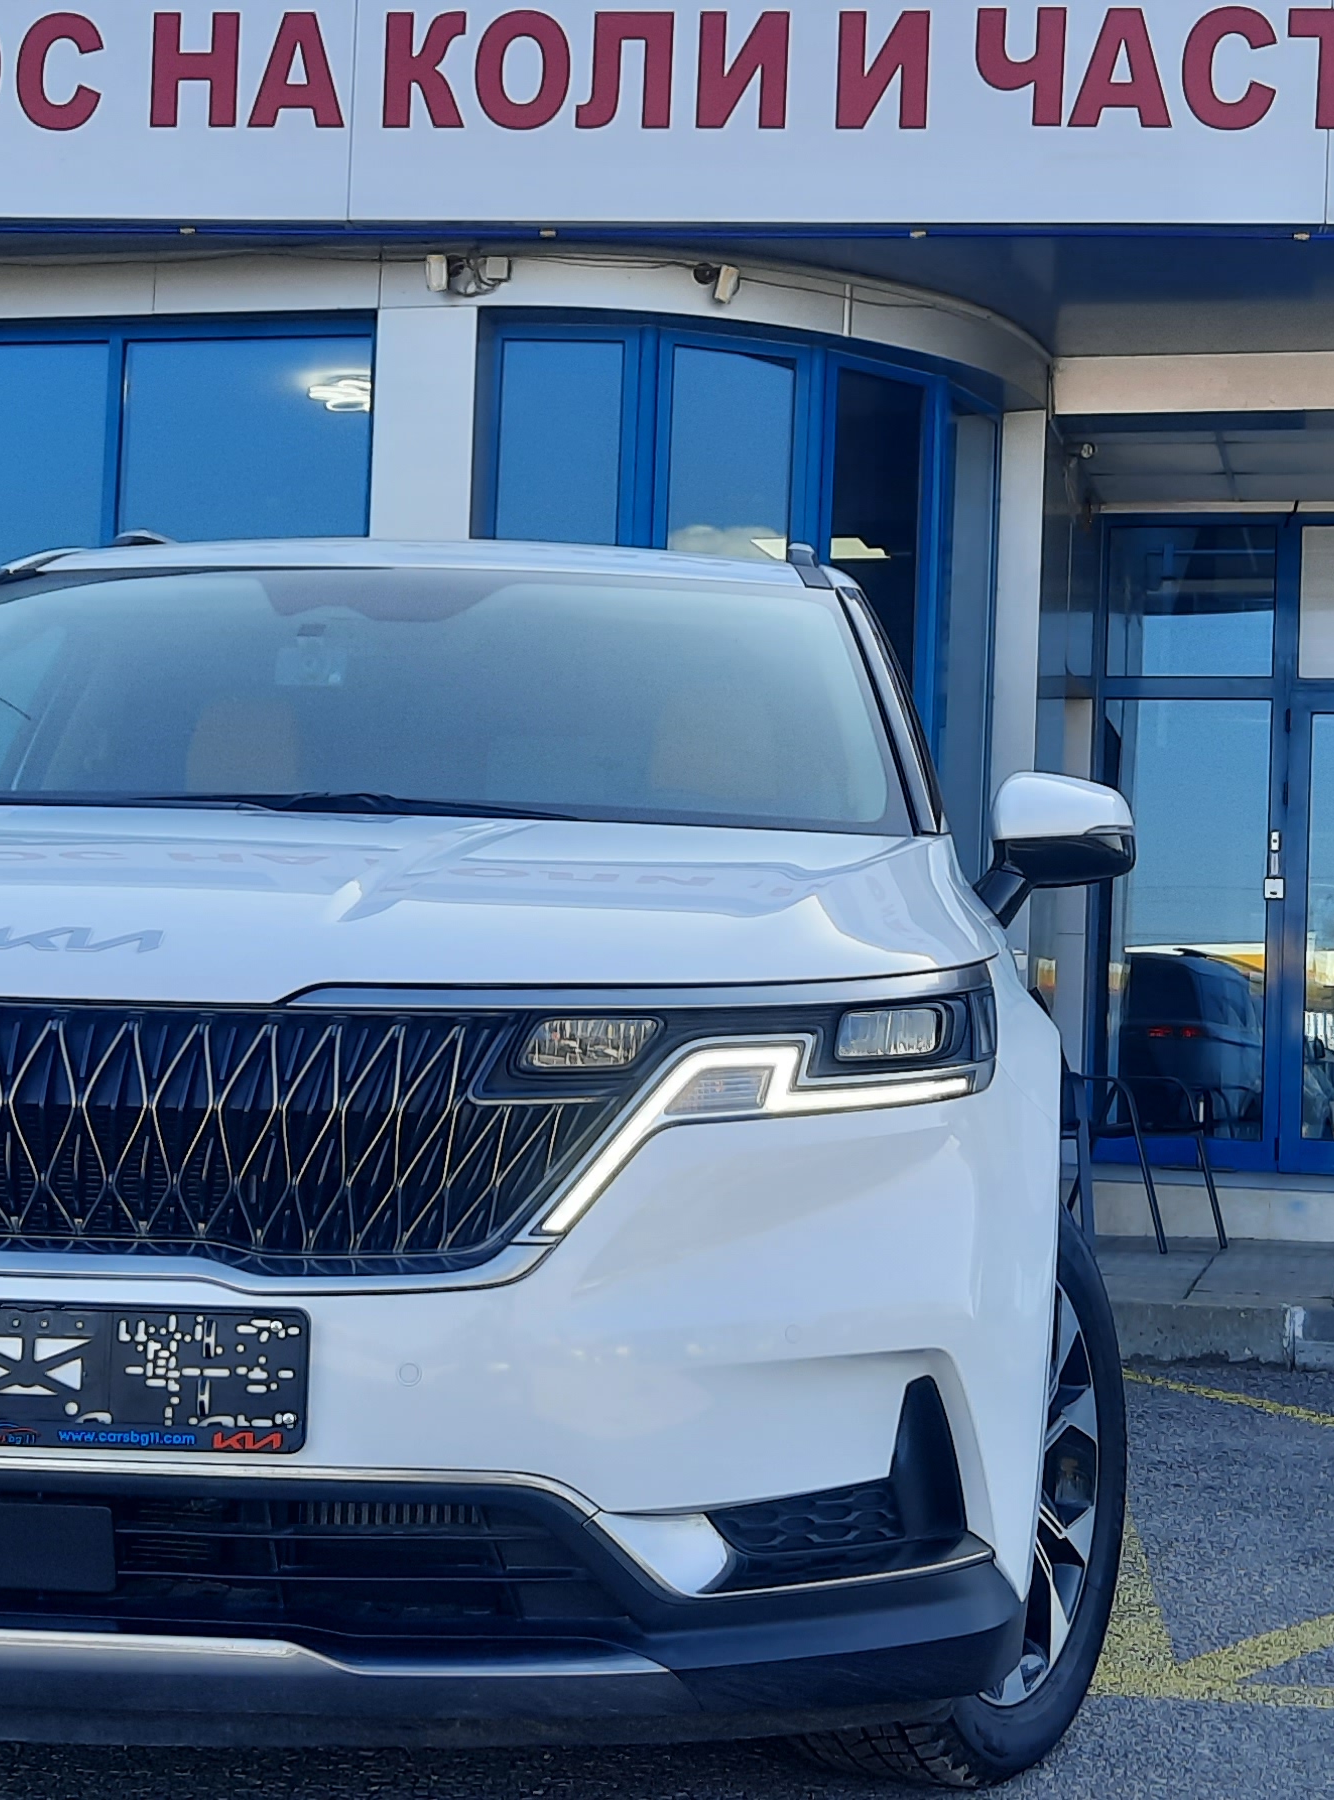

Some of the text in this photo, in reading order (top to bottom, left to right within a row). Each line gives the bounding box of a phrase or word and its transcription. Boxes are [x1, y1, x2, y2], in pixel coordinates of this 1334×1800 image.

[149, 11, 345, 129] НА
[381, 9, 791, 131] КОЛИ
[834, 9, 931, 130] И
[7, 1433, 23, 1445] bg
[58, 1430, 196, 1446] www.carsbg11.com
[213, 1431, 282, 1449] KIA
